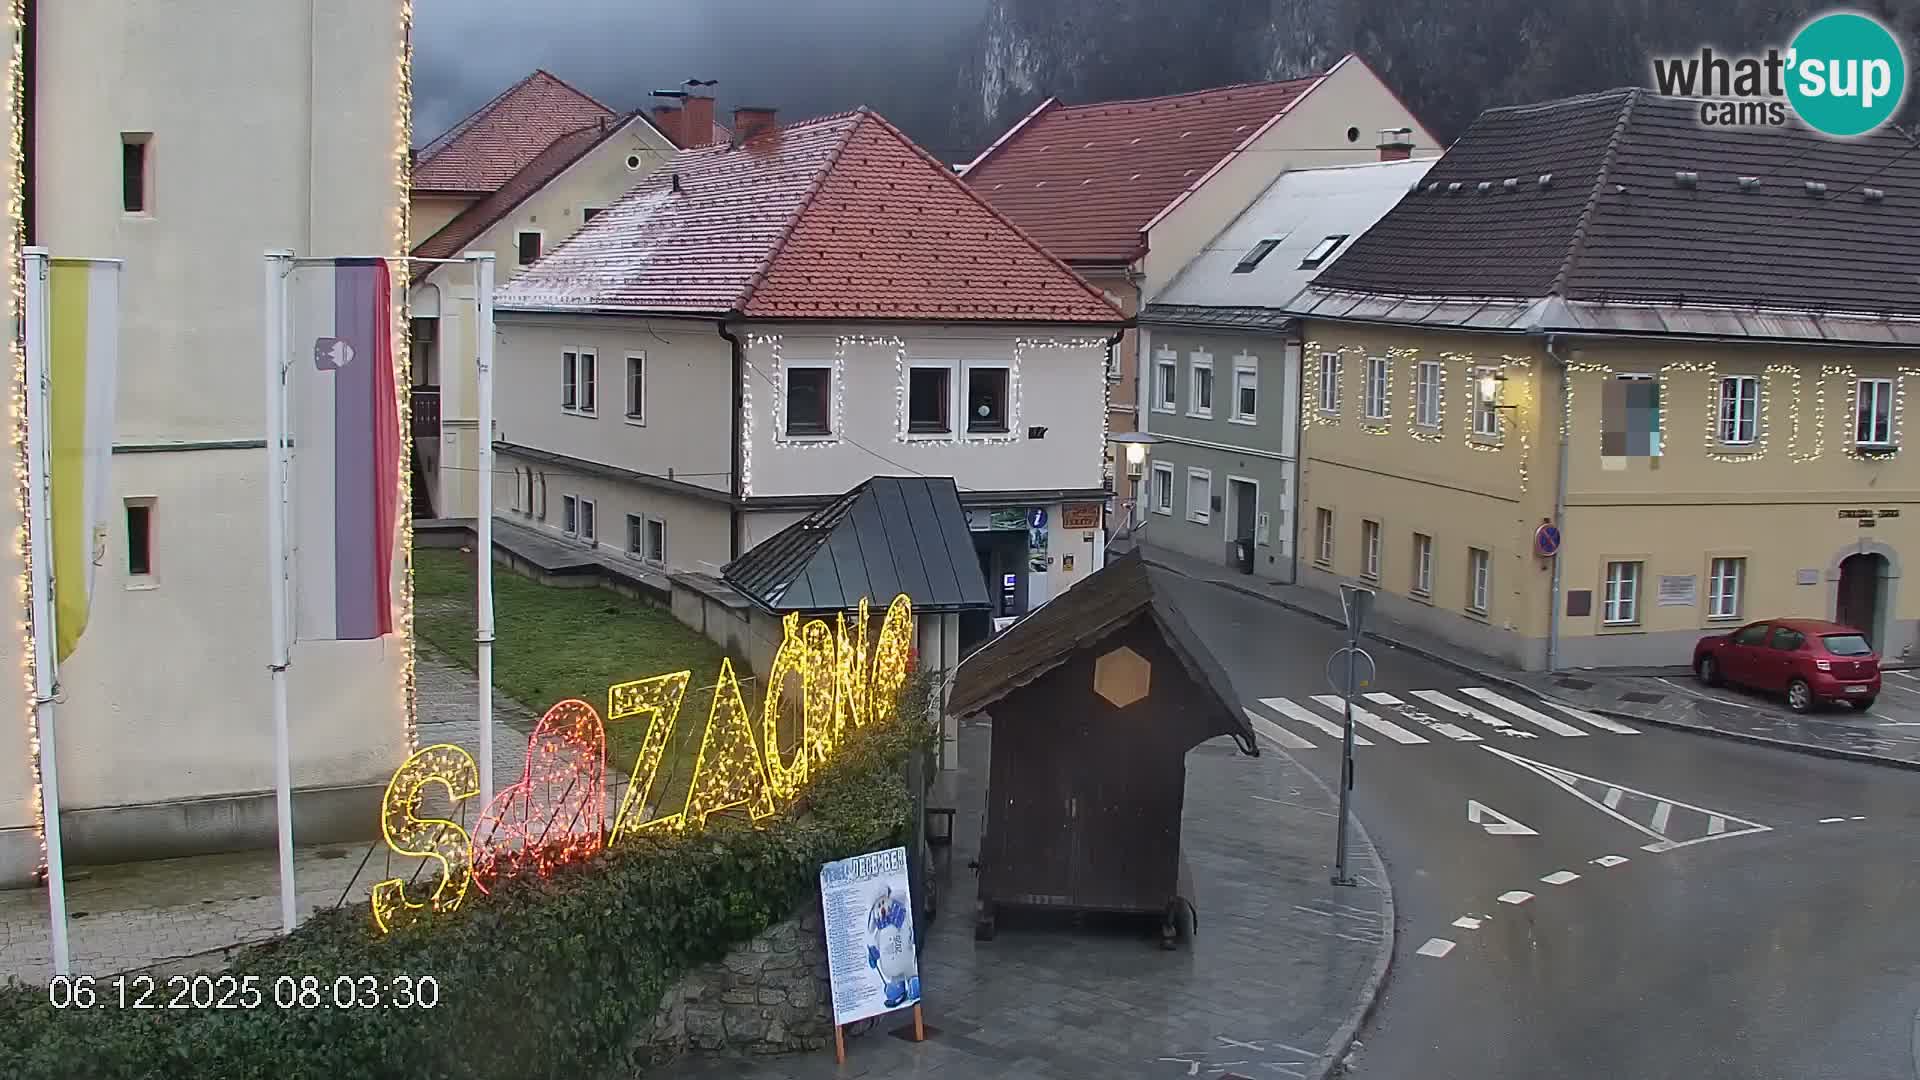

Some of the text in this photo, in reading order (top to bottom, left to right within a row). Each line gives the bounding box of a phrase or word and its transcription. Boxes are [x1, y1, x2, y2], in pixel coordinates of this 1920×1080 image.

[371, 743, 480, 934] S
[608, 657, 775, 847] ZA
[851, 849, 904, 877] DECEMBER
